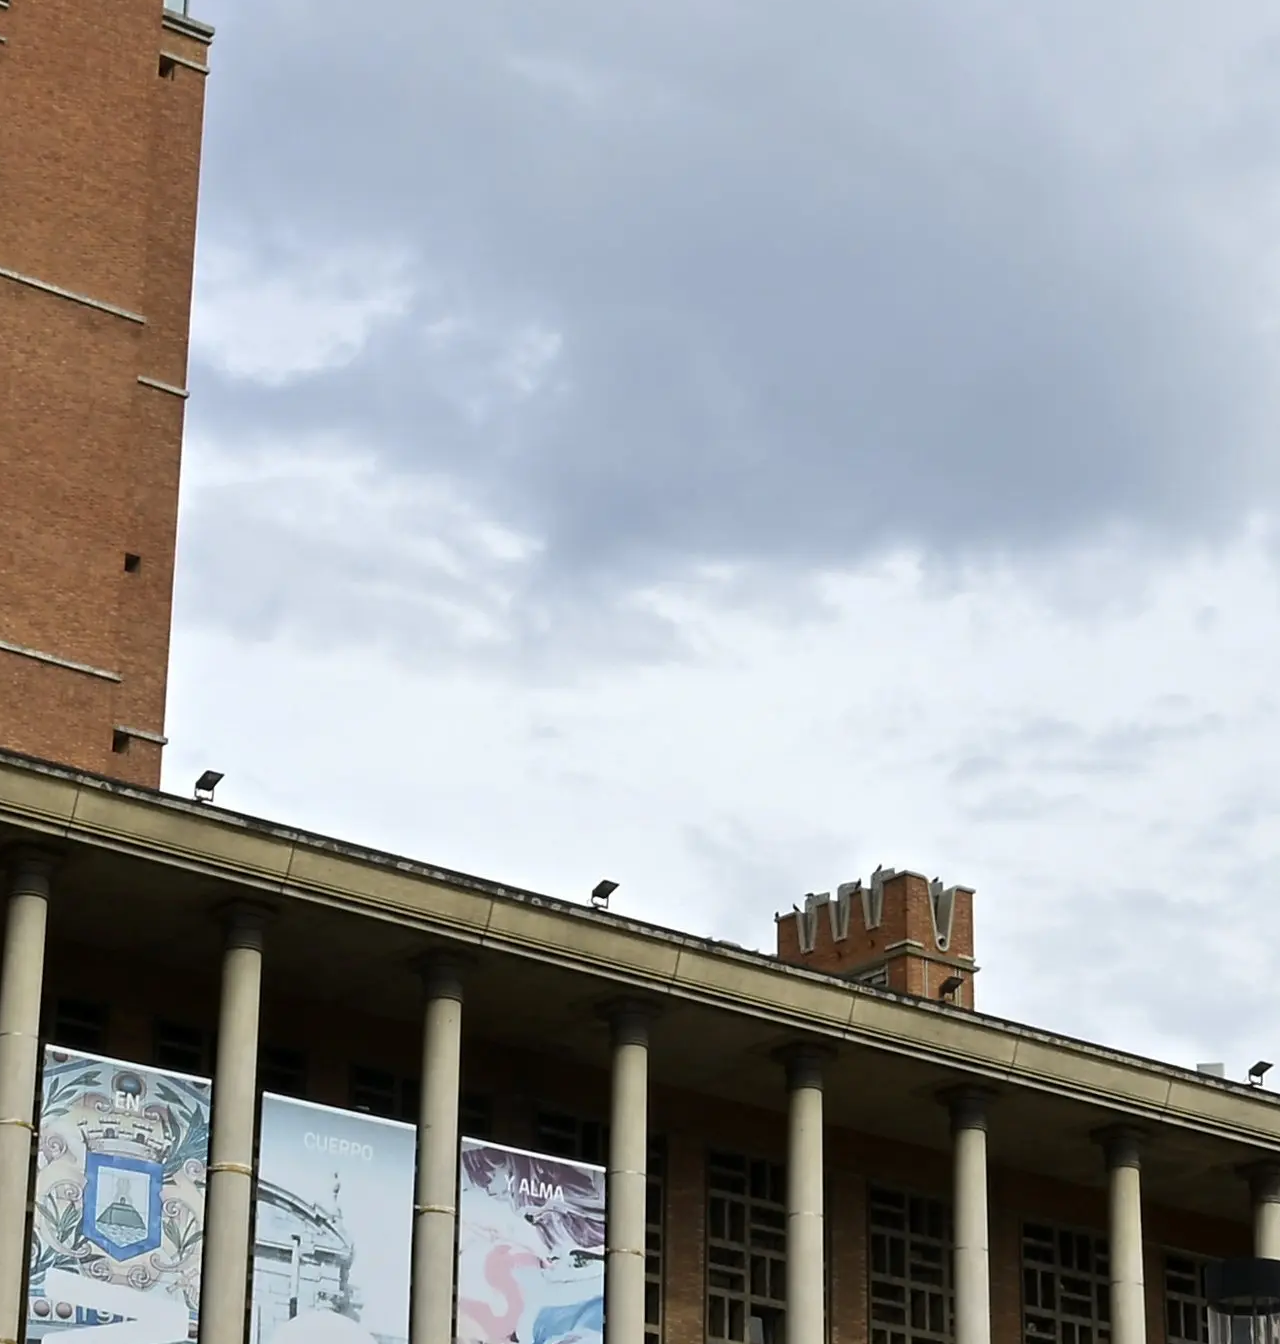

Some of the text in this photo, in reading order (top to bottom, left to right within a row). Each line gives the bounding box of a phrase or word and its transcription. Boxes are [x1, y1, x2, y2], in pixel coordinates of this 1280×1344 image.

[114, 1091, 140, 1112] EN
[303, 1131, 373, 1161] CUERPO
[519, 1177, 565, 1200] ALMA
